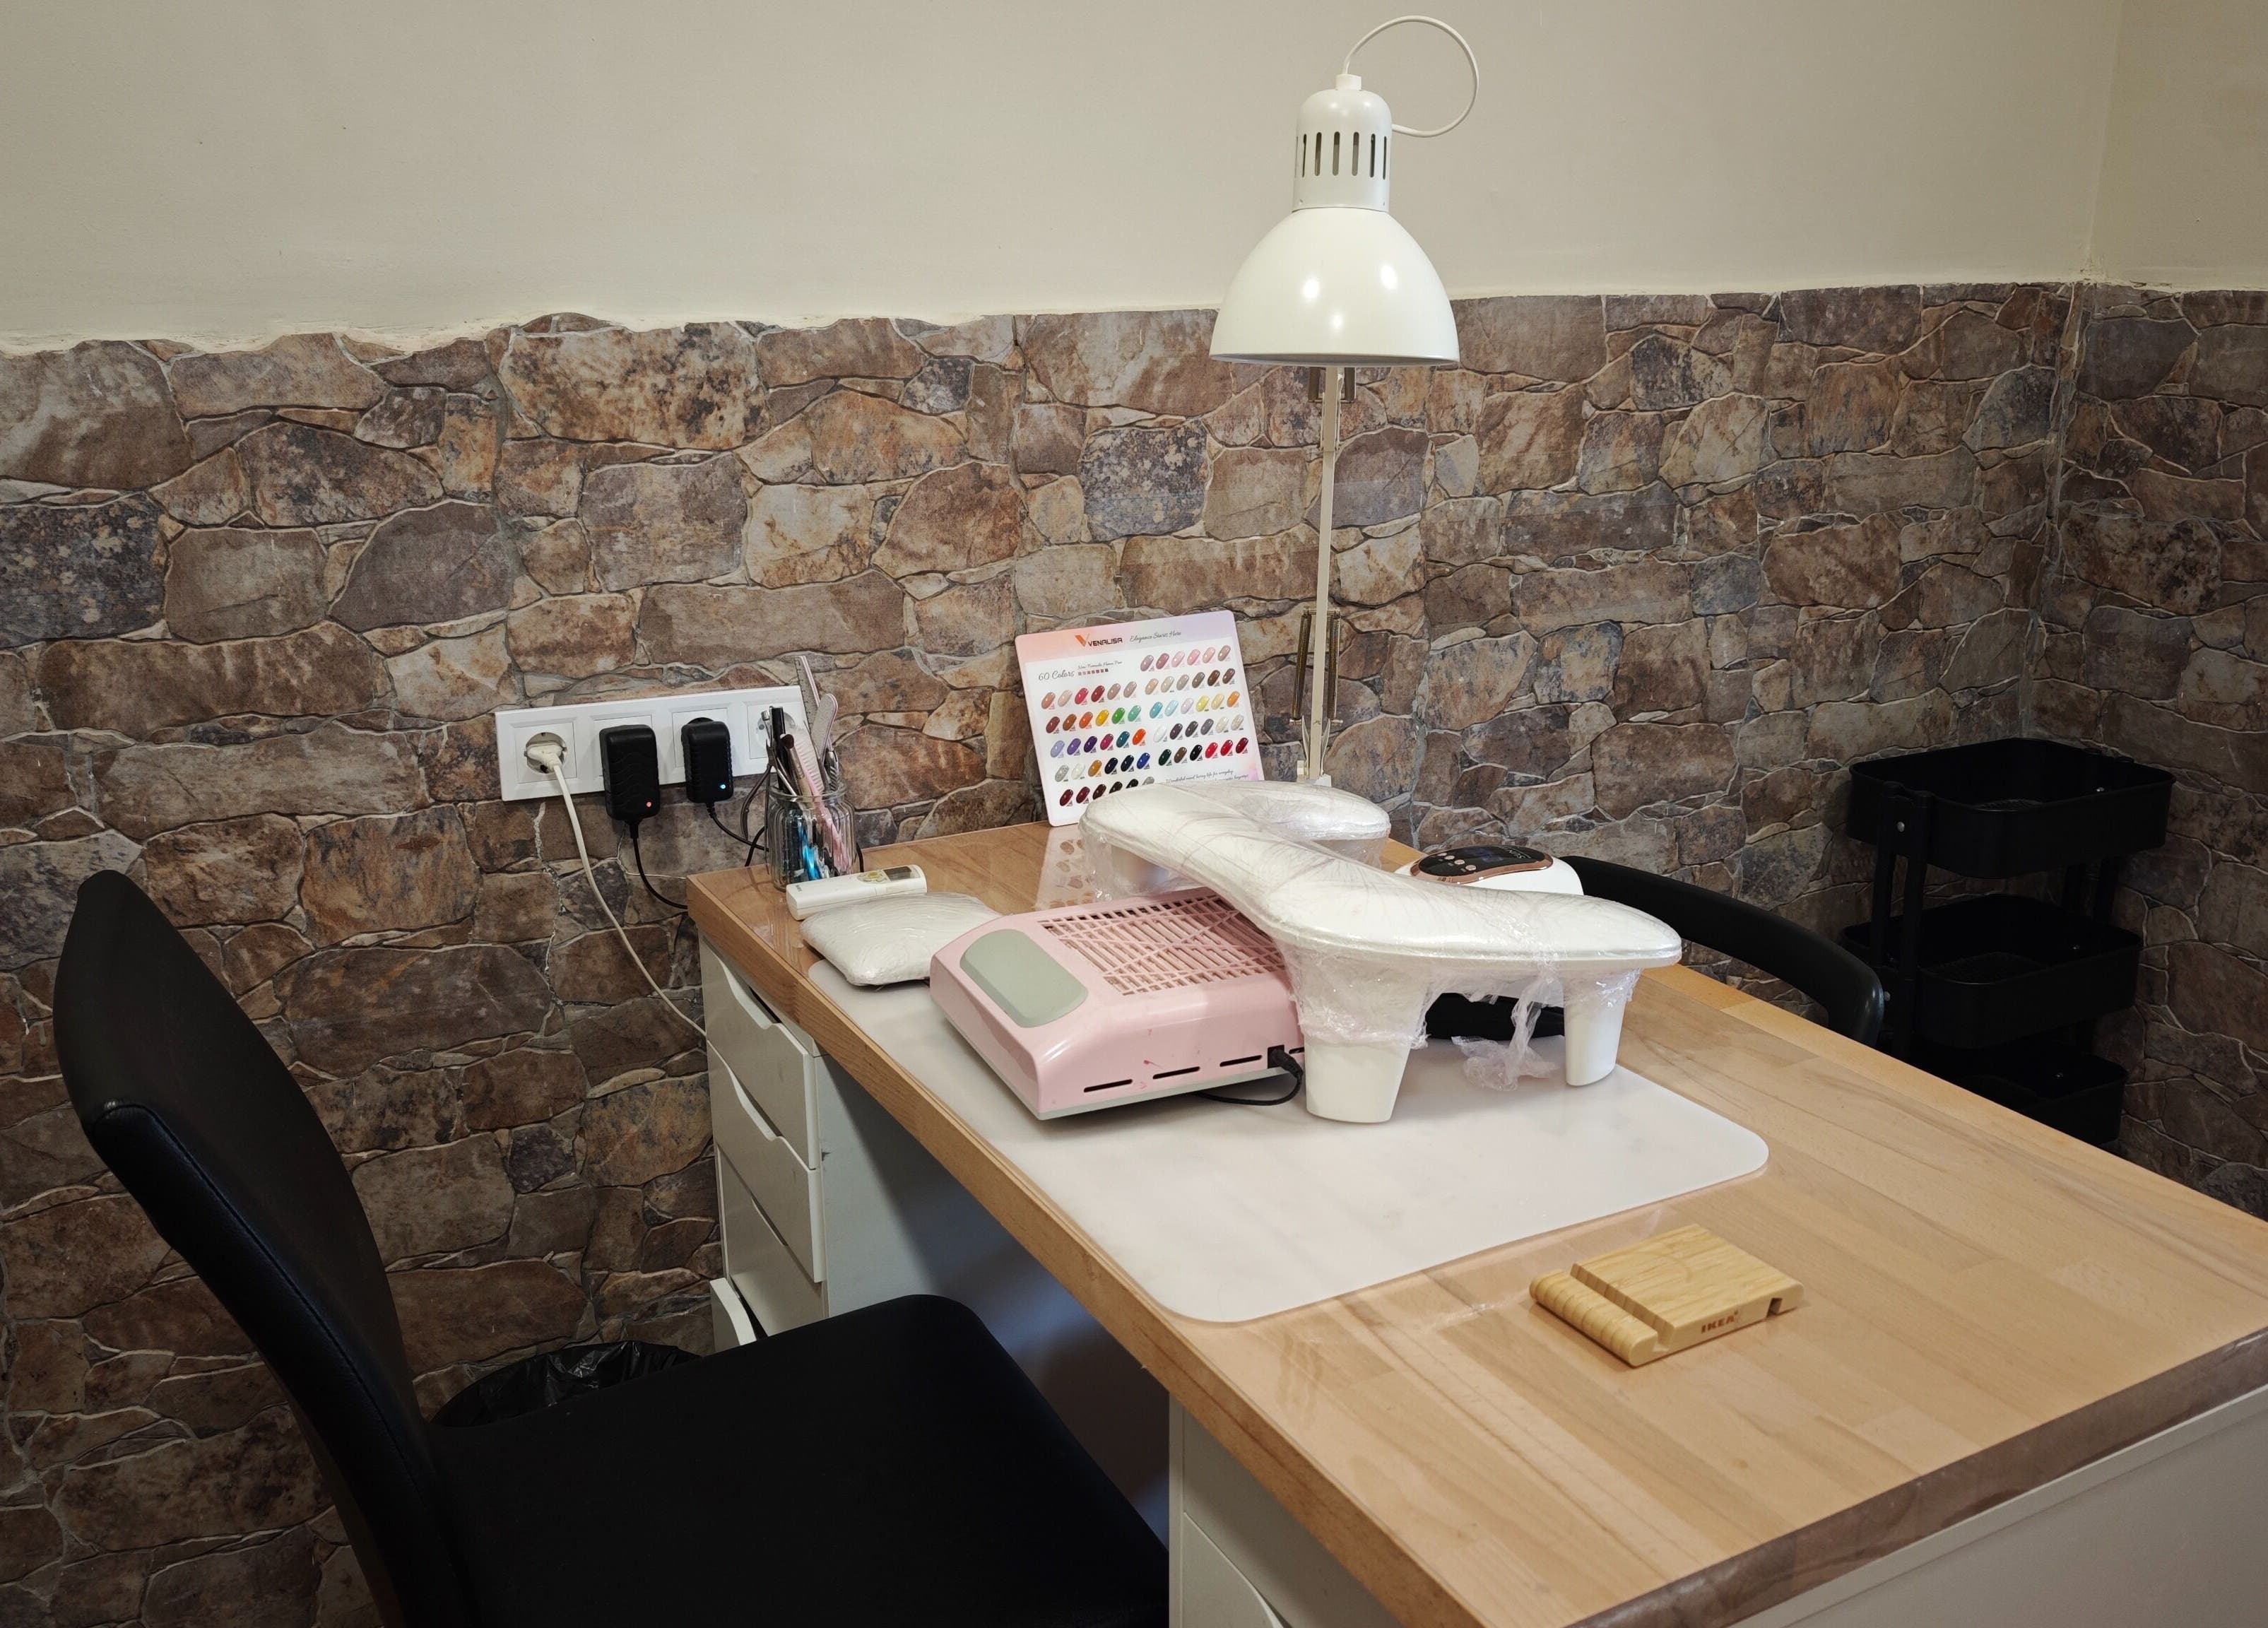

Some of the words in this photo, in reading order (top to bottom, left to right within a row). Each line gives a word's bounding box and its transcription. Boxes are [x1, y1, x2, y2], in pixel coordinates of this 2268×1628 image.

[1088, 637, 1123, 647] VENALISA
[1039, 672, 1050, 680] 60
[1052, 669, 1075, 680] Colors
